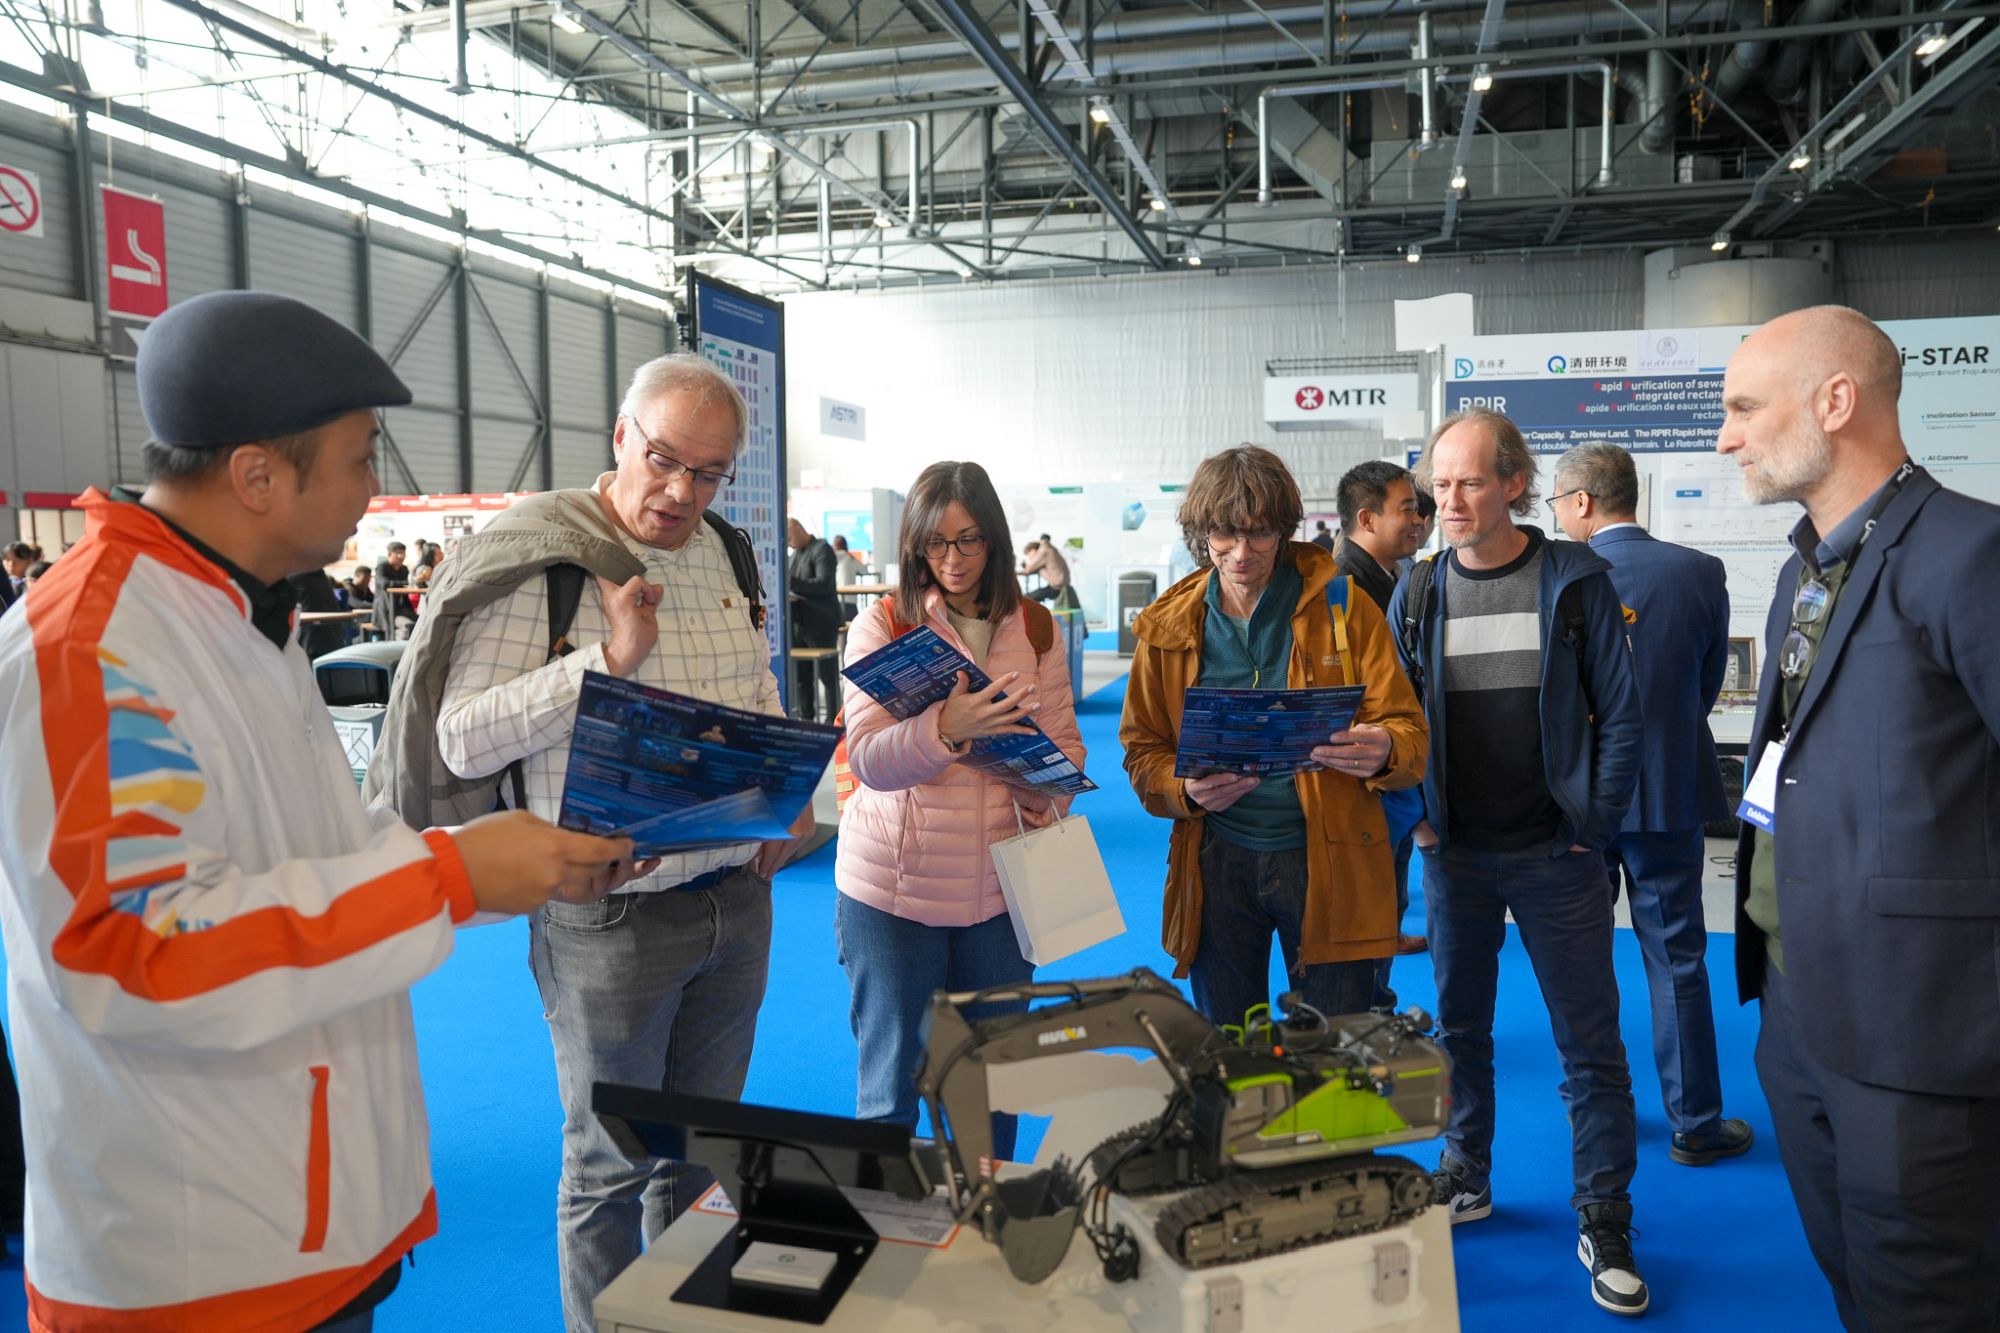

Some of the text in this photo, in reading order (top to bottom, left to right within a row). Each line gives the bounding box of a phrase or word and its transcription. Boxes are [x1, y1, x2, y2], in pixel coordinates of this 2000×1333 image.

[1570, 356, 1627, 369] 清研环境
[1901, 346, 1990, 366] i-STAR
[1593, 380, 1623, 394] Rapid
[1623, 379, 1684, 392] Purification
[1685, 379, 1696, 389] of
[1328, 388, 1387, 407] MTR
[1632, 390, 1685, 403] Integrated
[1578, 402, 1610, 415] Rapide
[1611, 401, 1663, 412] Purification
[1664, 401, 1675, 411] de
[1676, 402, 1699, 410] eaux
[1926, 410, 1969, 419] Inclination
[1569, 430, 1588, 439] Zero
[1589, 430, 1607, 438] New
[1607, 429, 1630, 438] Land.
[1634, 428, 1650, 438] The
[1650, 428, 1672, 437] RPIR
[1672, 428, 1697, 439] Rapid
[1664, 440, 1675, 448] Le
[1676, 439, 1706, 448] Retrofit
[1747, 807, 1770, 825] Exhibitor
